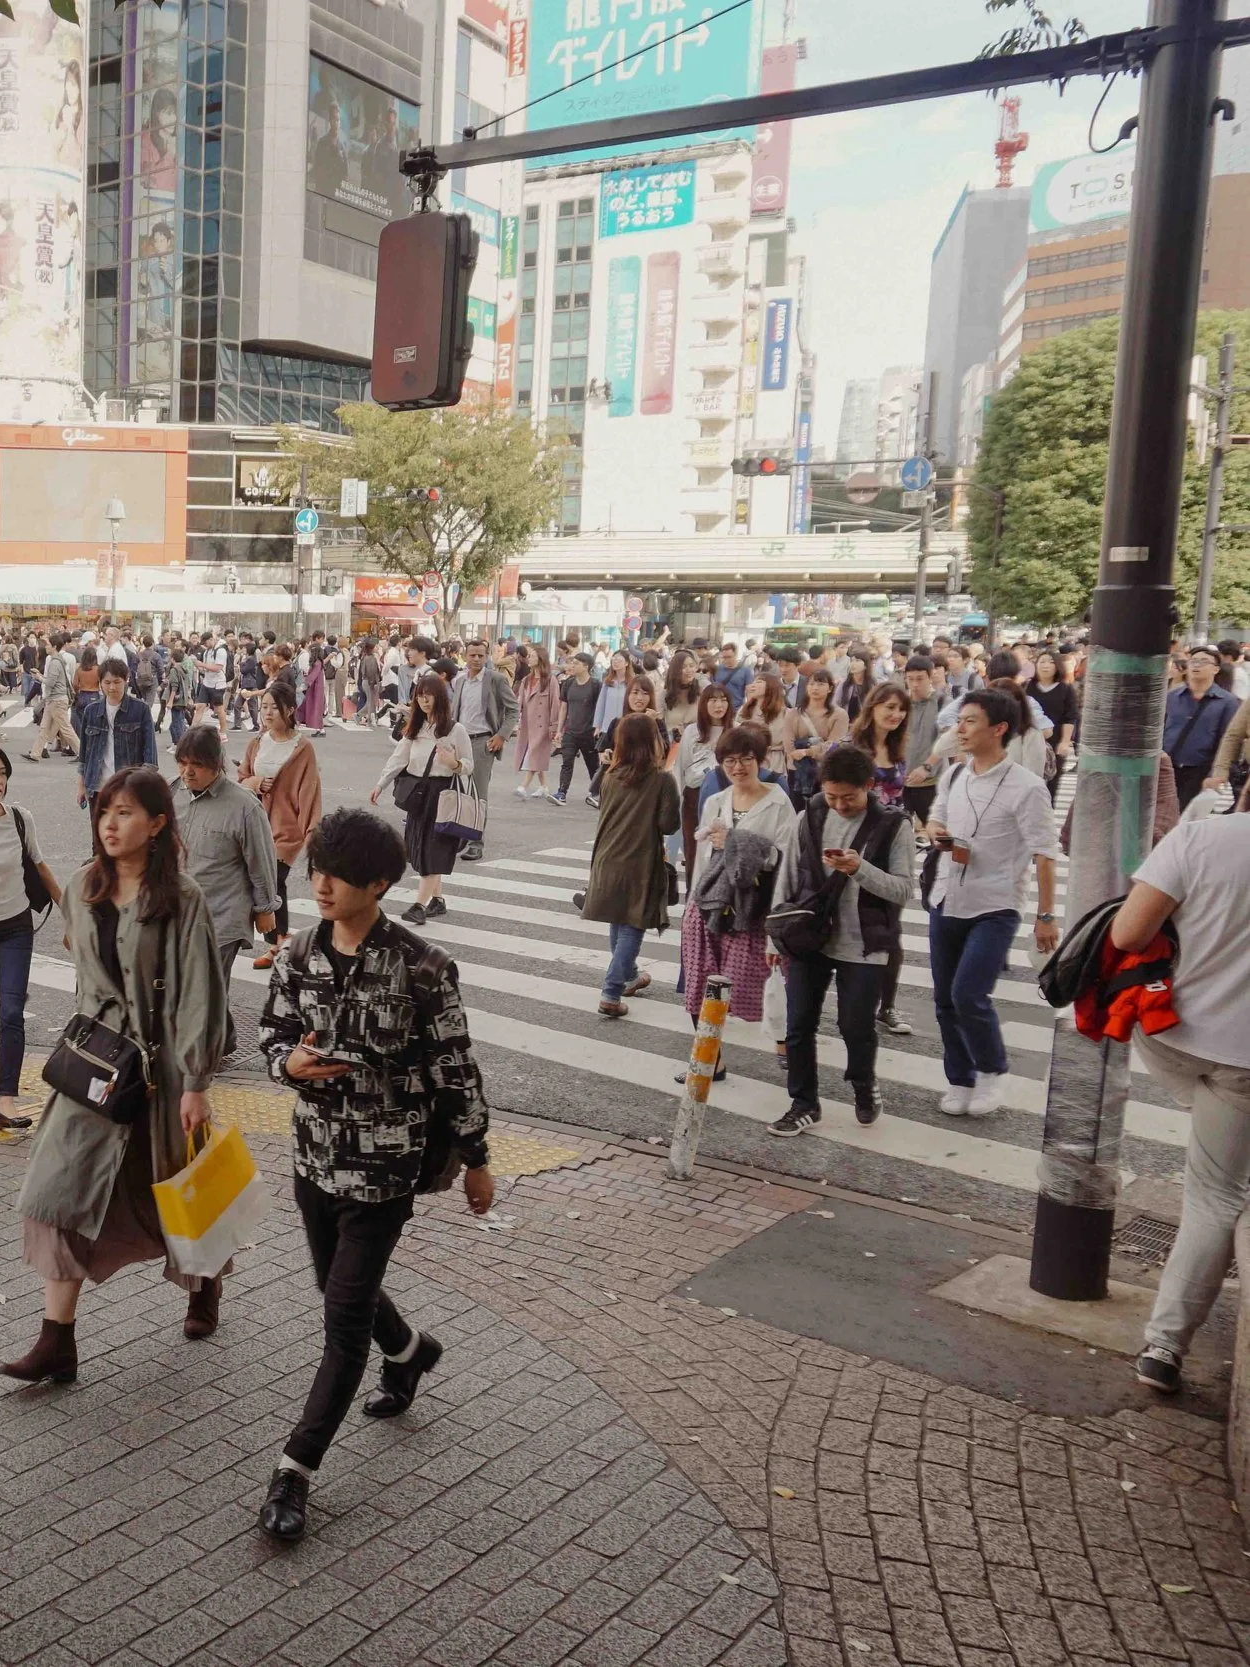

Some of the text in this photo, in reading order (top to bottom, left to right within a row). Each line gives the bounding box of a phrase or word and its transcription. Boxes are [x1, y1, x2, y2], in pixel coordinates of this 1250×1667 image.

[546, 8, 711, 91] ダイレクト
[618, 206, 675, 228] うるおう
[774, 304, 788, 343] MIZUHO
[760, 541, 786, 558] JR
